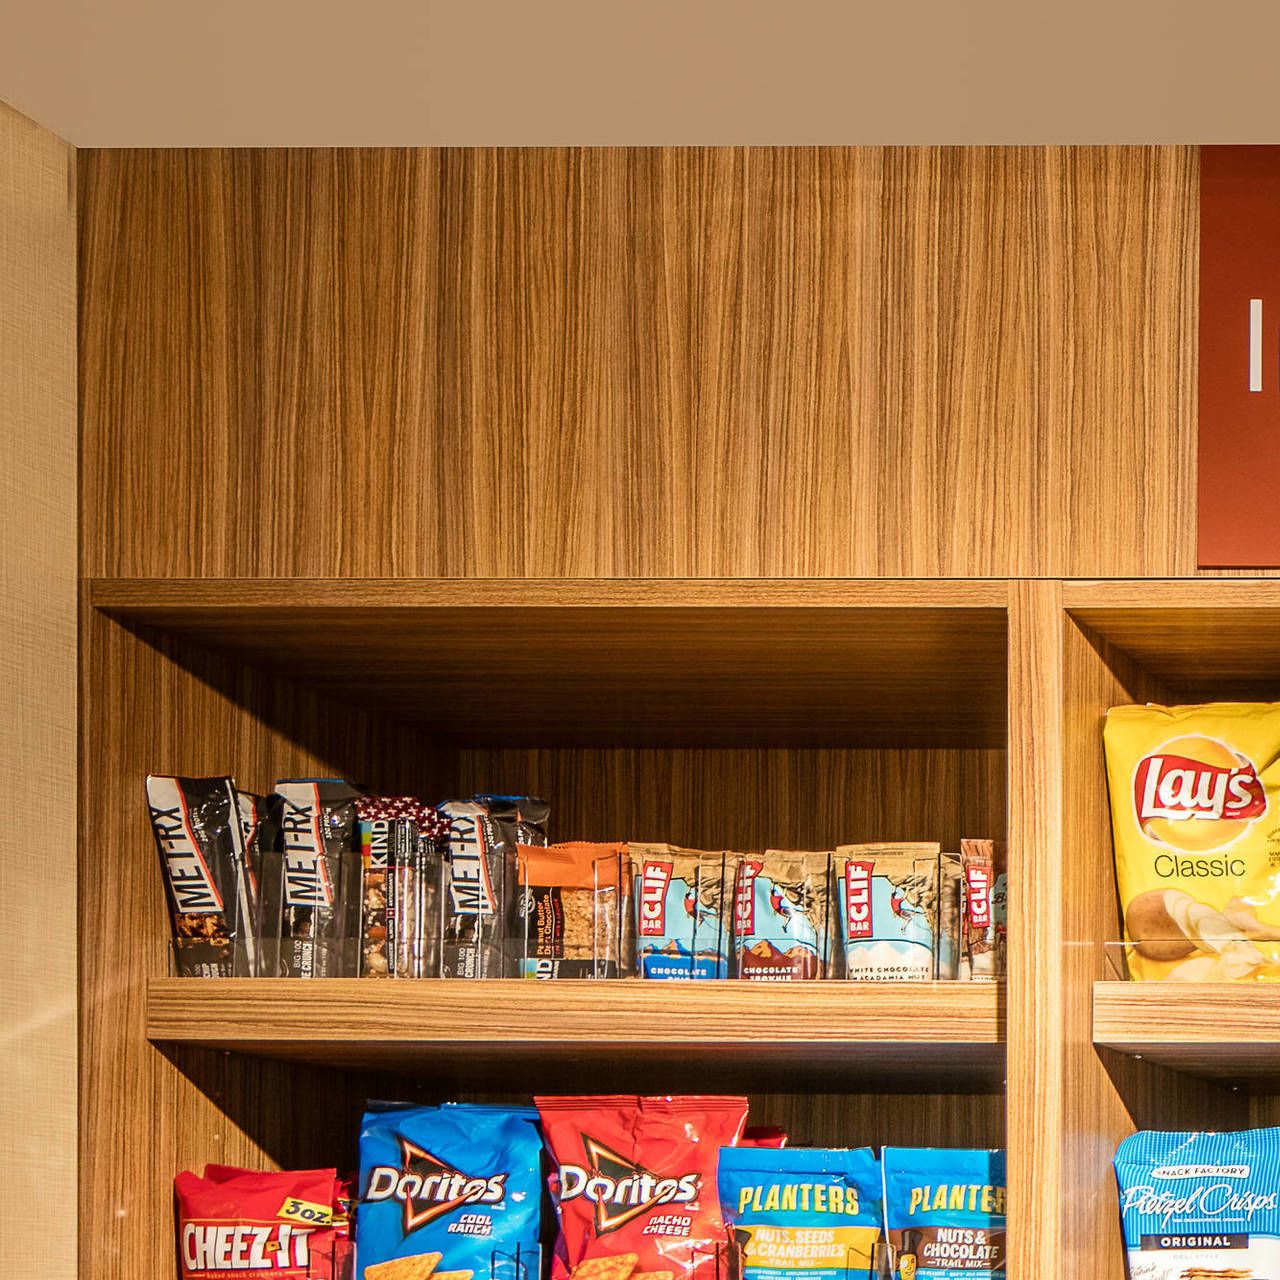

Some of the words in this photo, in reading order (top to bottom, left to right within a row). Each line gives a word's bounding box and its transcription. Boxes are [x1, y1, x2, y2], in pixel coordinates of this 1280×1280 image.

[1140, 757, 1256, 821] Lay's
[283, 804, 330, 903] MET-RX
[370, 820, 389, 870] KIND
[1153, 854, 1246, 879] Classic
[643, 861, 668, 919] CLIF
[736, 861, 760, 919] CLIF
[849, 862, 872, 920] CLIF
[969, 866, 990, 914] CLIF
[650, 966, 708, 976] CHOCOLATE
[743, 966, 799, 975] CHOCOLATE
[365, 1165, 508, 1203] Doritos
[559, 1165, 701, 1204] Doritos
[737, 1184, 860, 1217] PLANTERS
[447, 1223, 493, 1236] RANCH
[459, 1213, 493, 1226] COOL
[642, 1225, 692, 1237] CHEESE
[648, 1215, 692, 1228] NACHO
[937, 1228, 974, 1244] NUTS
[974, 1230, 987, 1245] &
[1160, 1236, 1231, 1249] ORIGINAL
[923, 1242, 1000, 1259] CHOCOLATE
[935, 1258, 964, 1268] TRAIL
[965, 1259, 983, 1268] MIX
